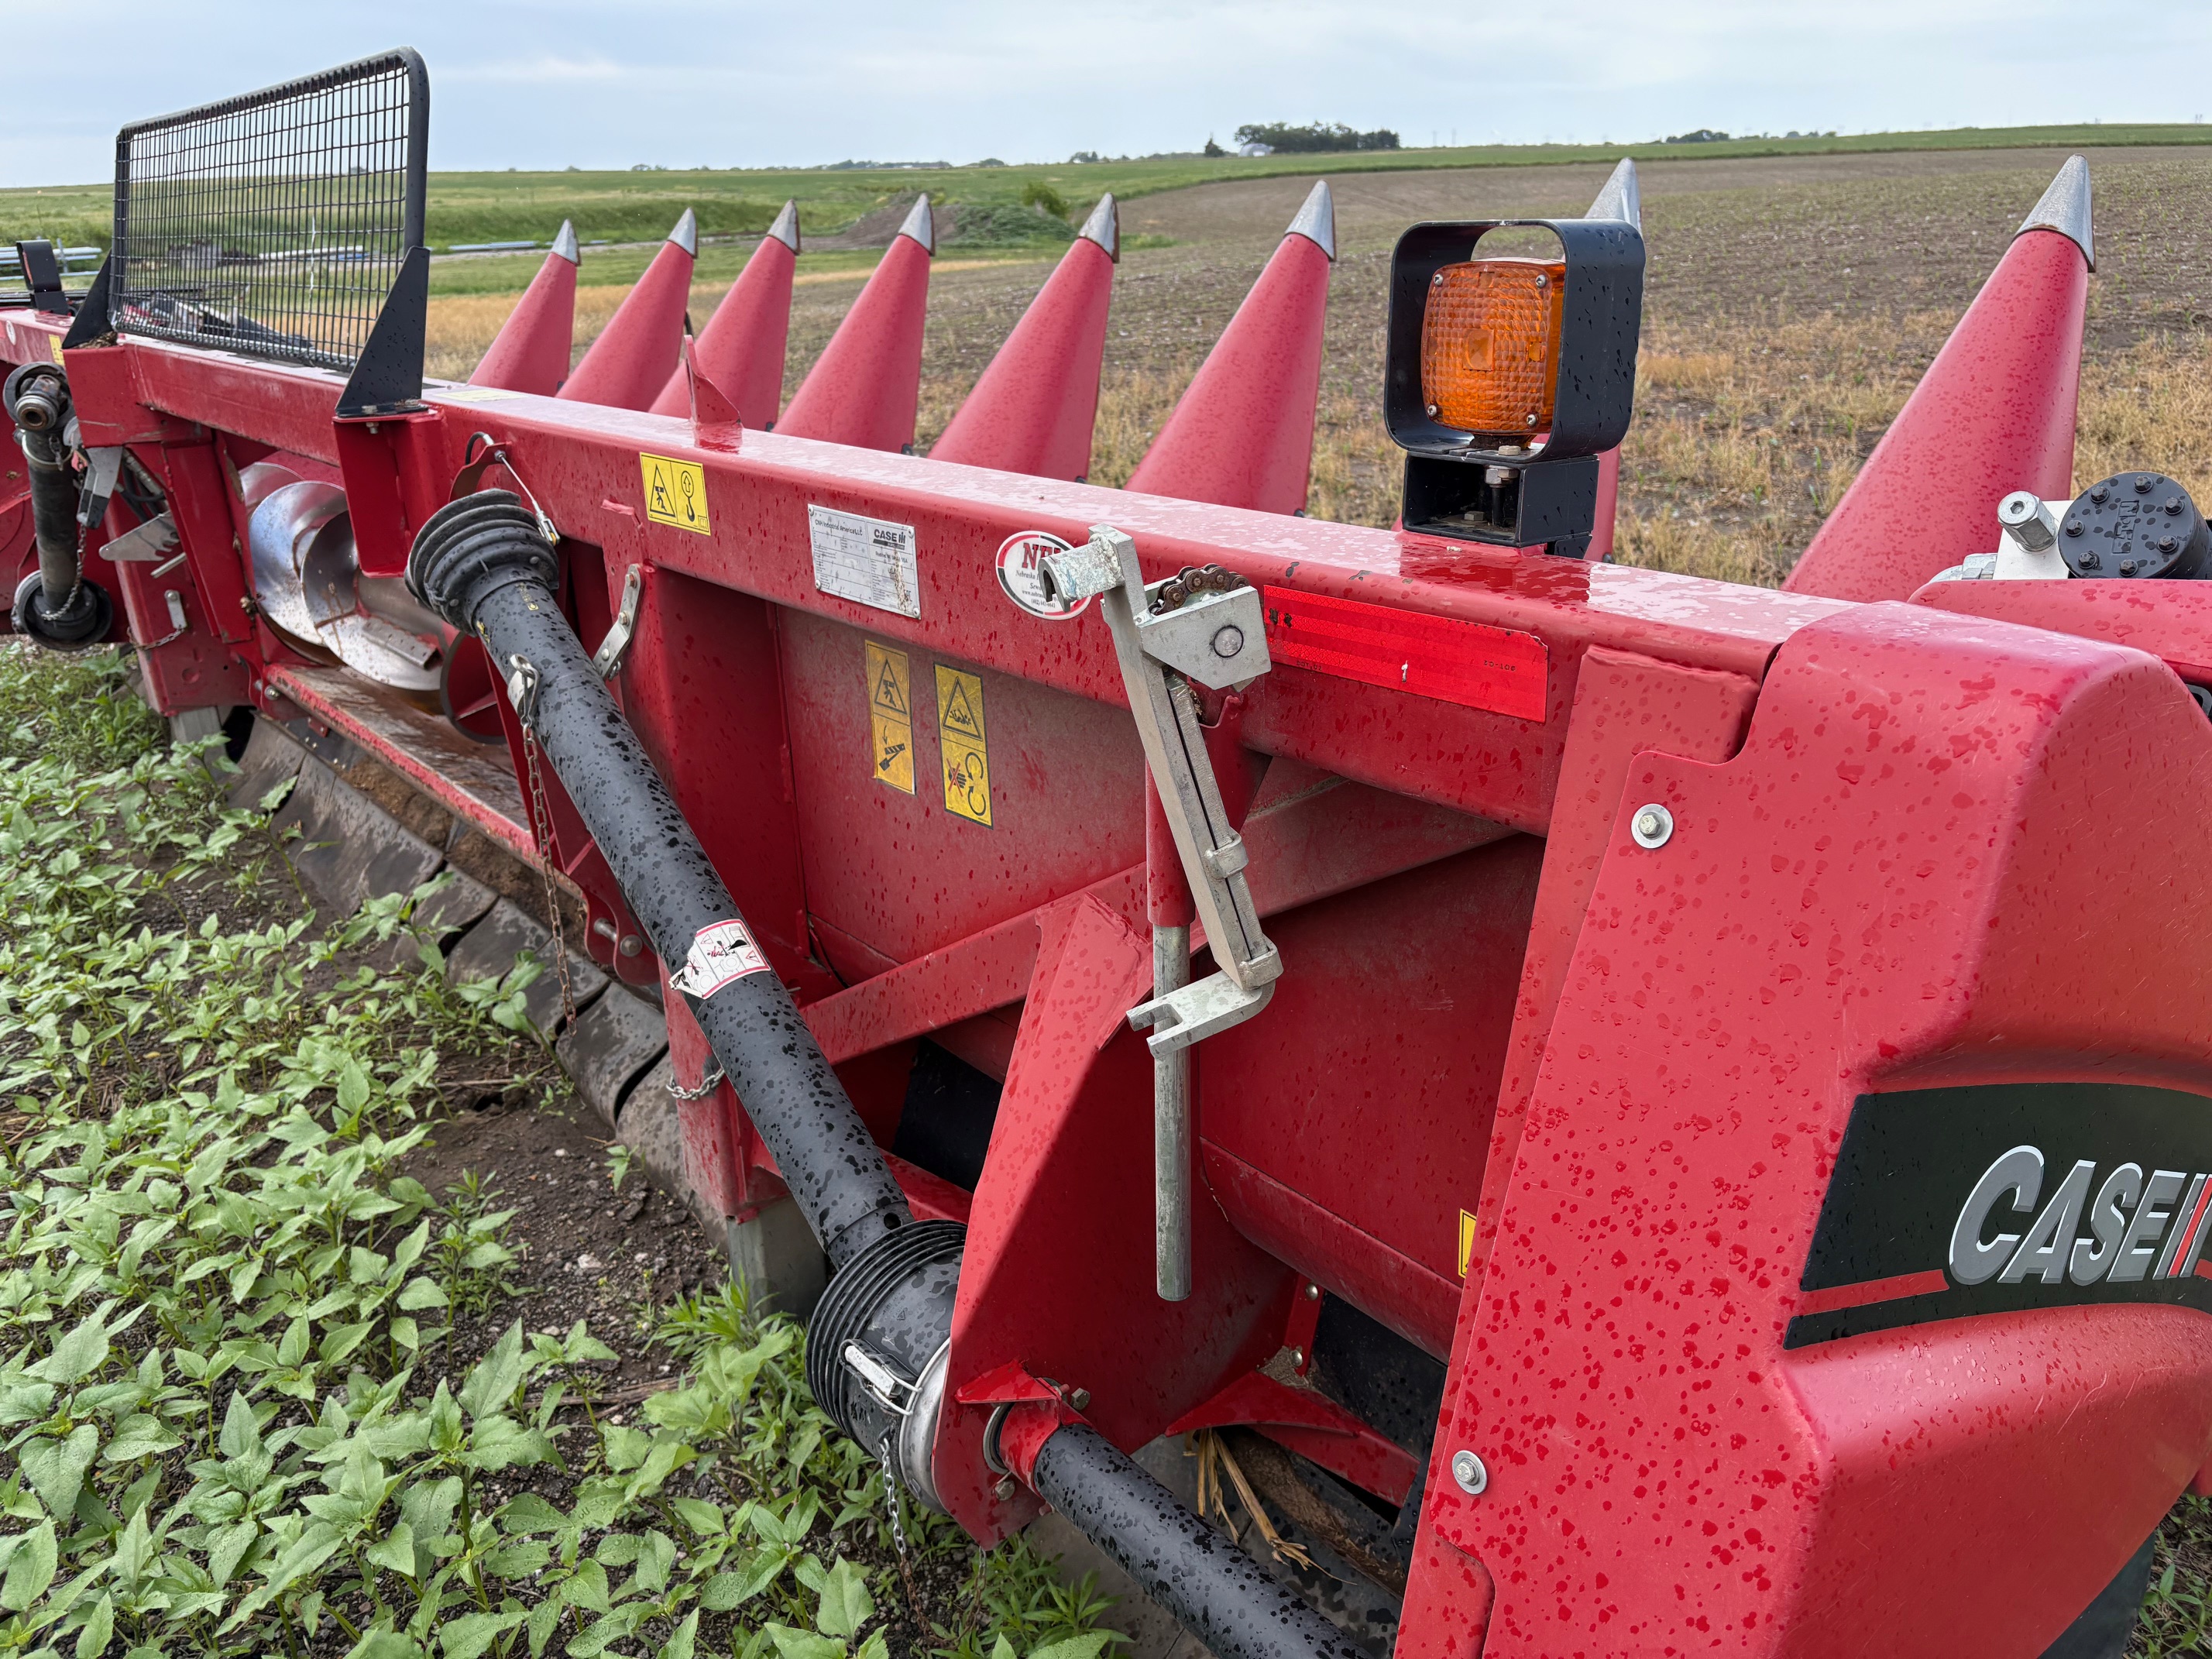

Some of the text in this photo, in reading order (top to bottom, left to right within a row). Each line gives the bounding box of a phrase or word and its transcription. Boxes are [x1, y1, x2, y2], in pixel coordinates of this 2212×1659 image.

[874, 528, 898, 542] CASE
[1015, 569, 1036, 579] Nebraska
[1949, 1145, 2187, 1286] CASE
